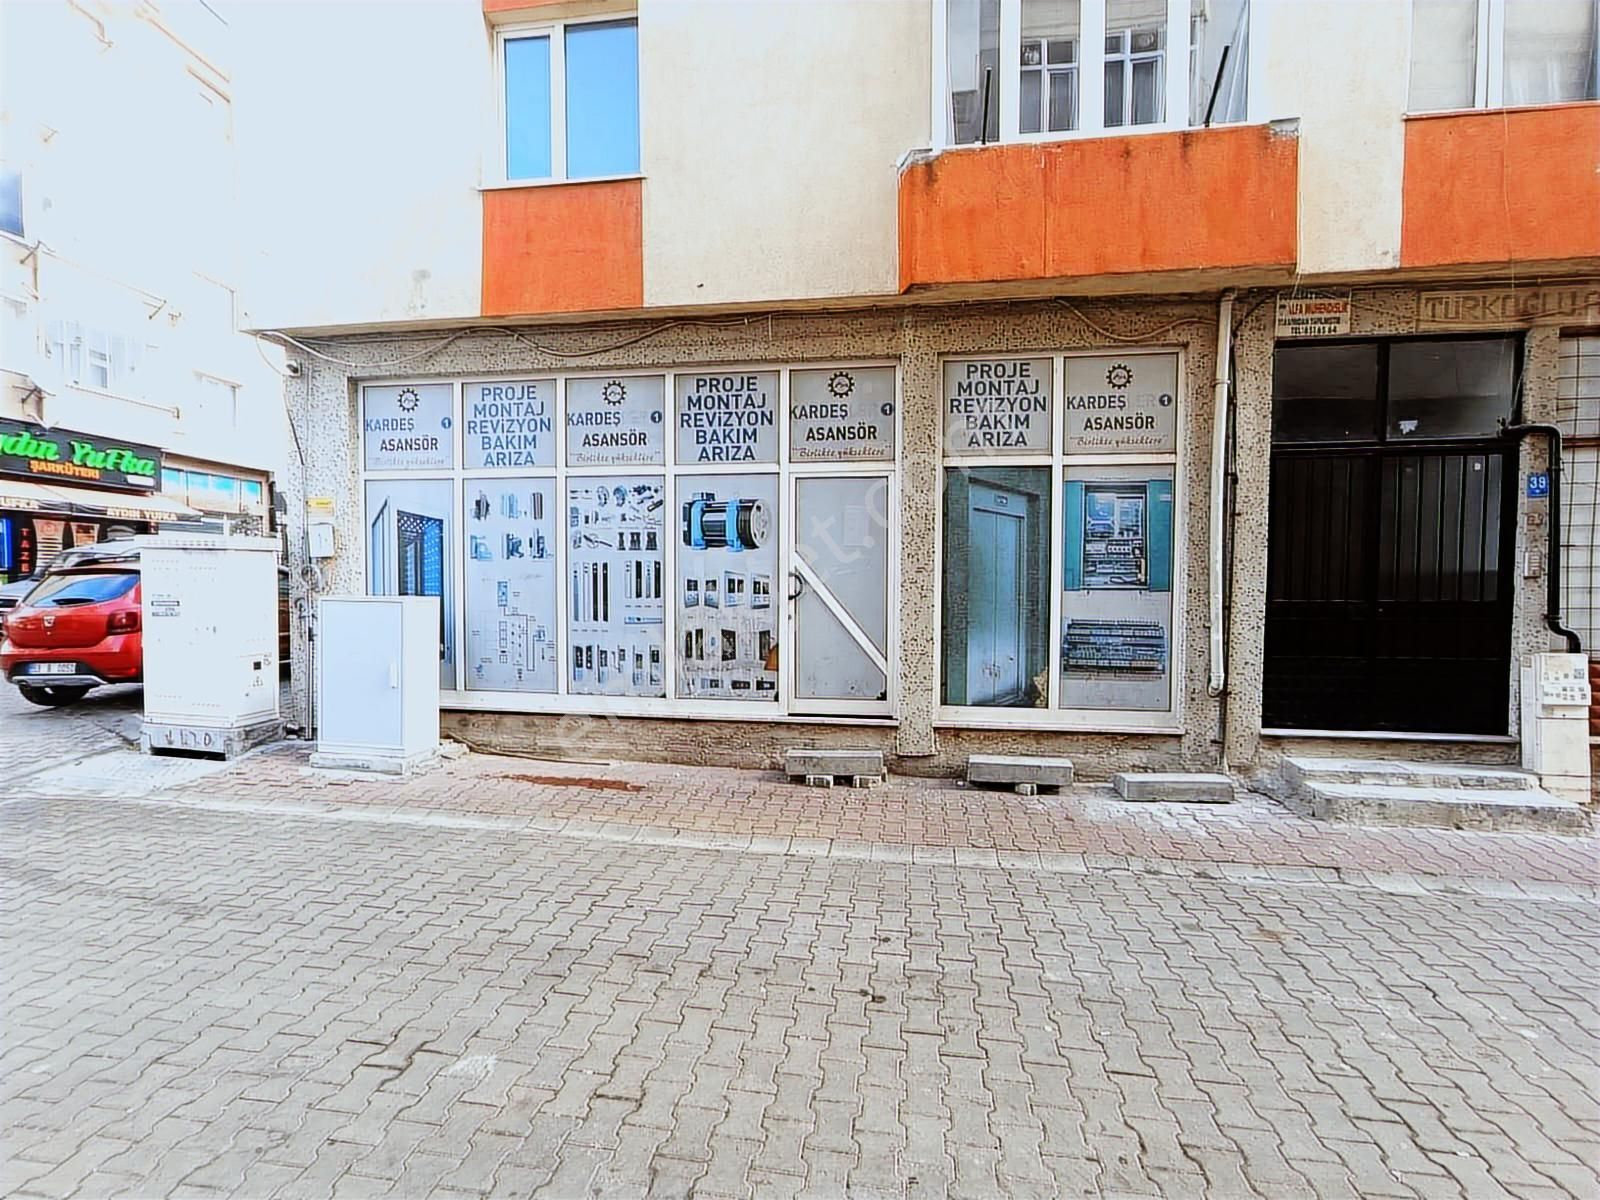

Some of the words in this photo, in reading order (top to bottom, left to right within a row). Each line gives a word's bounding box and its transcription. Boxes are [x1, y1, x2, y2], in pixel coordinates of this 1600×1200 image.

[967, 362, 1031, 379] PROJE
[695, 376, 758, 393] PROJE
[957, 379, 1040, 396] MONTAJ
[481, 385, 537, 402] PROJE
[687, 393, 767, 411] MONTAJ
[473, 401, 544, 418] MONTAJ
[1066, 395, 1127, 411] KARDEŞ
[567, 411, 621, 427] KARDEŞ
[966, 414, 1030, 430] BAKIM
[1083, 412, 1154, 431] ASANSÖR
[582, 429, 647, 447] ASANSÖR
[695, 428, 758, 445] BAKIM
[806, 422, 877, 441] ASANSÖR
[968, 431, 1027, 447] ARIZA
[380, 434, 439, 451] ASANSÖR
[481, 434, 537, 450] BAKIM
[483, 450, 535, 466] ARIZA
[698, 445, 756, 461] ARIZA
